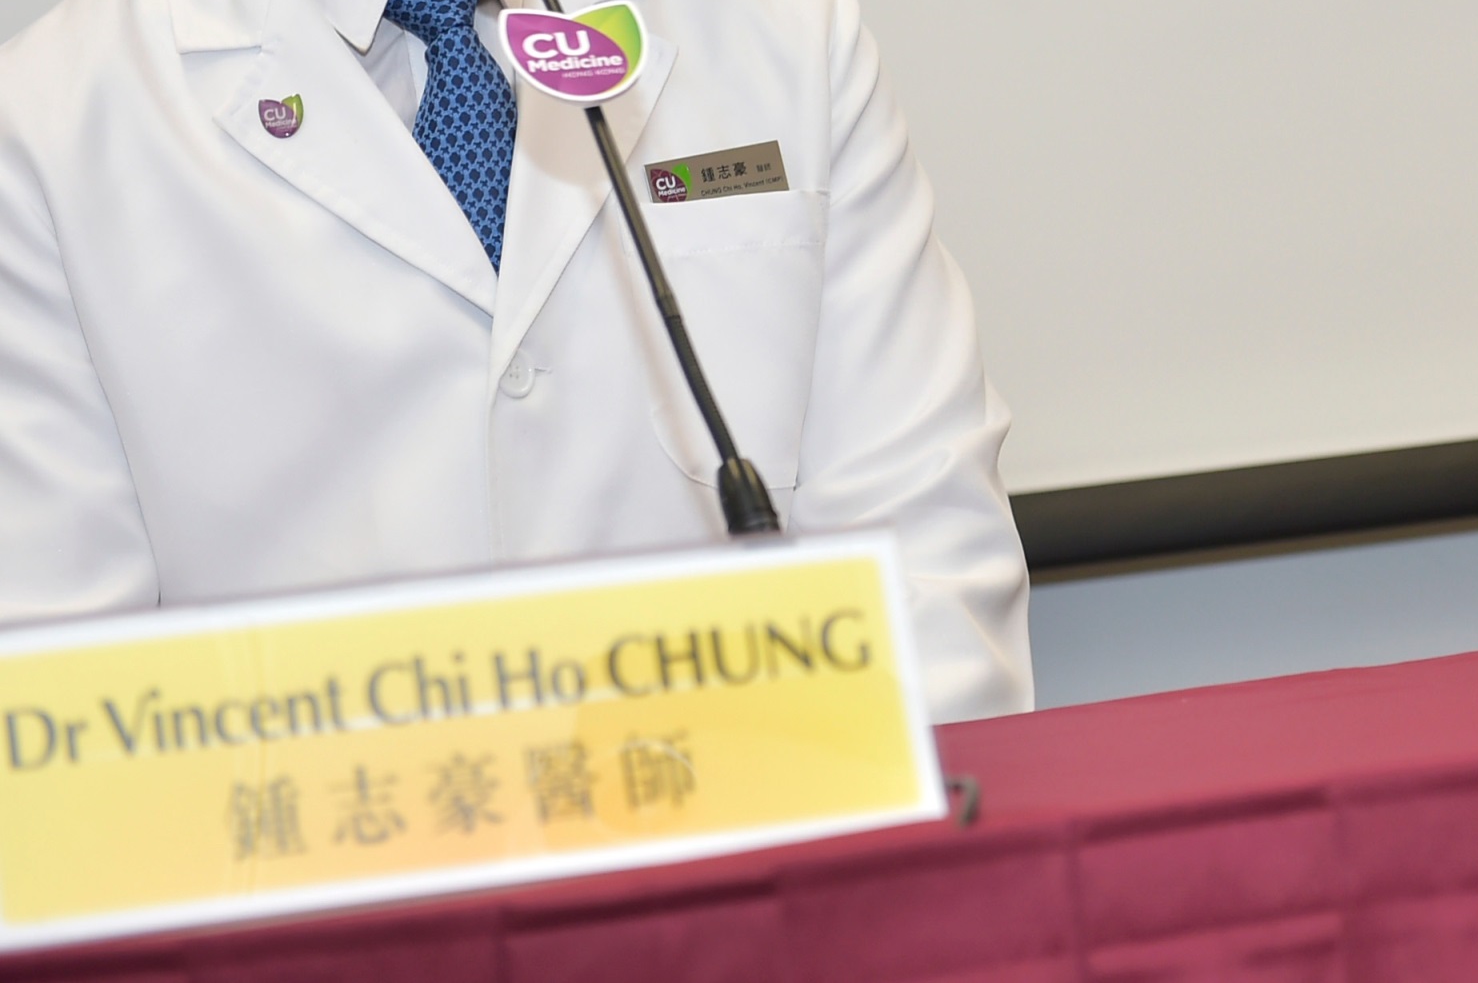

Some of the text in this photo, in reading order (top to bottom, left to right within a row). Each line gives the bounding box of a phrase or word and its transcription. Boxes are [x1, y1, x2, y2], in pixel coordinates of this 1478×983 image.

[522, 30, 591, 59] CU
[526, 55, 623, 73] Medicine
[264, 106, 287, 121] CU
[655, 176, 677, 191] CU
[657, 187, 686, 197] Medicine
[2, 608, 875, 771] Dr Vincent Chi Ho CHUNG
